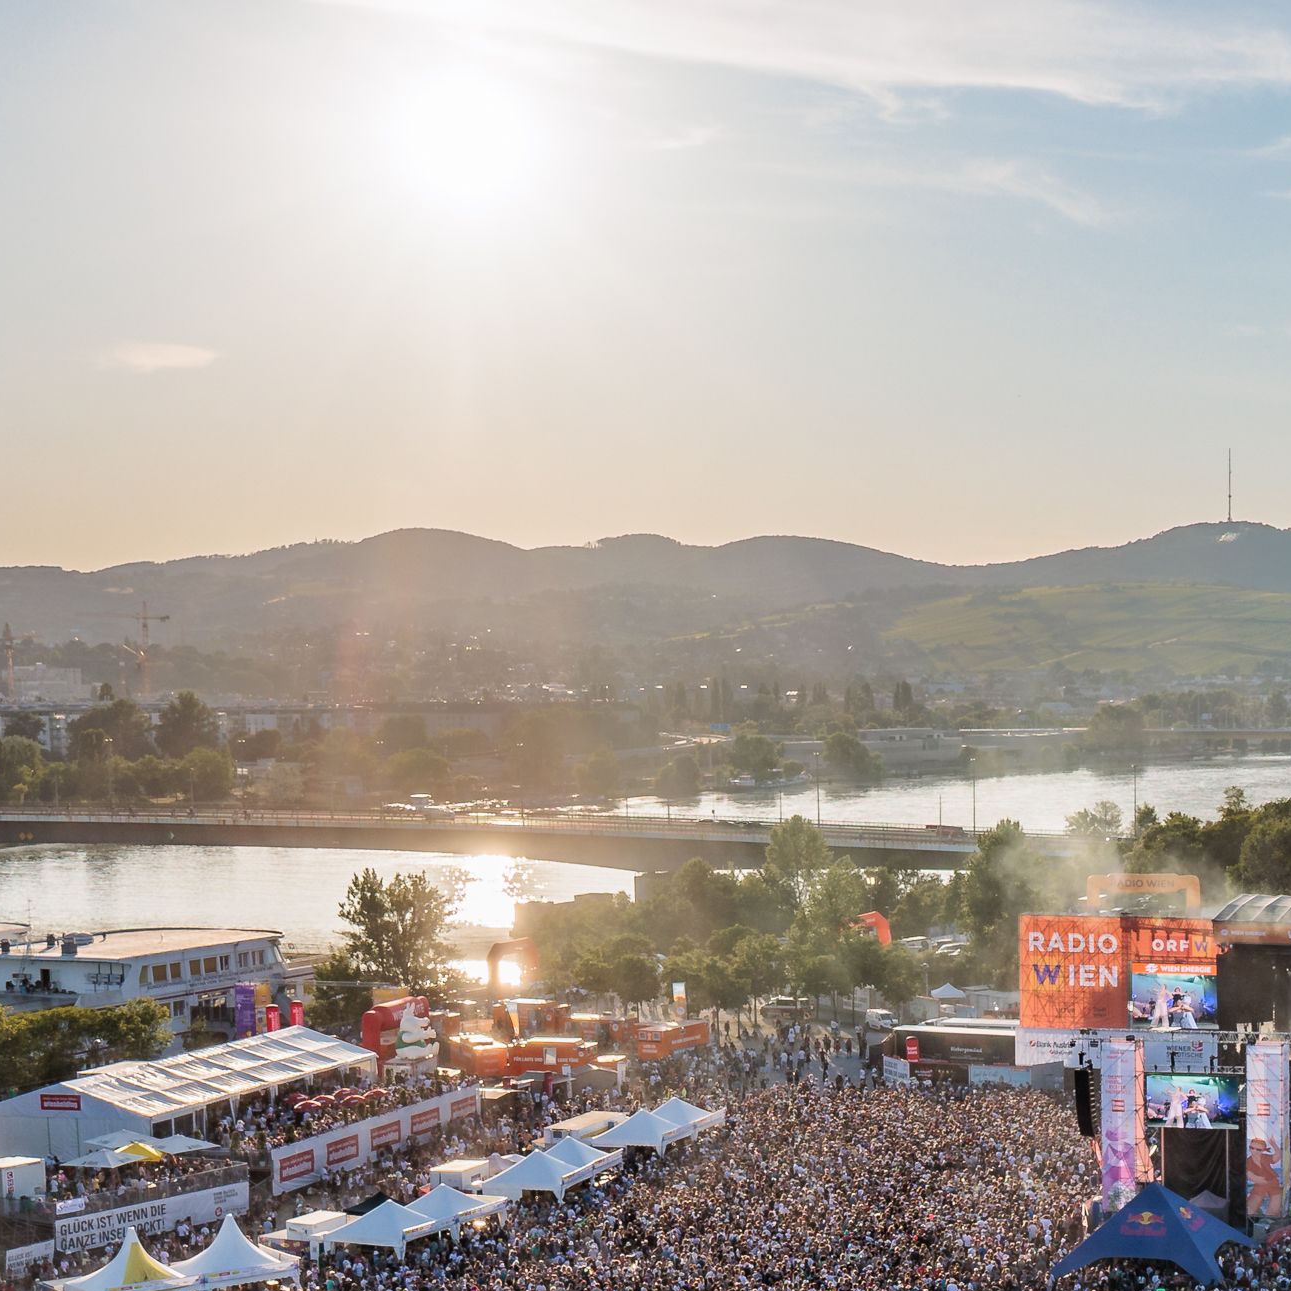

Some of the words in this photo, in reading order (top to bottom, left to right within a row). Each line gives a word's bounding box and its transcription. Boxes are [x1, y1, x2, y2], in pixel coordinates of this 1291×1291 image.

[1027, 931, 1118, 954] RADIO
[1152, 938, 1189, 952] ORF
[1032, 963, 1118, 988] WIEN
[1160, 965, 1181, 974] WIEN
[1182, 966, 1212, 974] ENERGIE
[1036, 1040, 1051, 1048] Bank
[60, 1217, 94, 1236] GLÜCK
[96, 1214, 115, 1227] IST,
[116, 1208, 149, 1226] WENN
[149, 1203, 167, 1217] DIE
[60, 1233, 97, 1250] GANZE
[98, 1227, 127, 1244] INSEL
